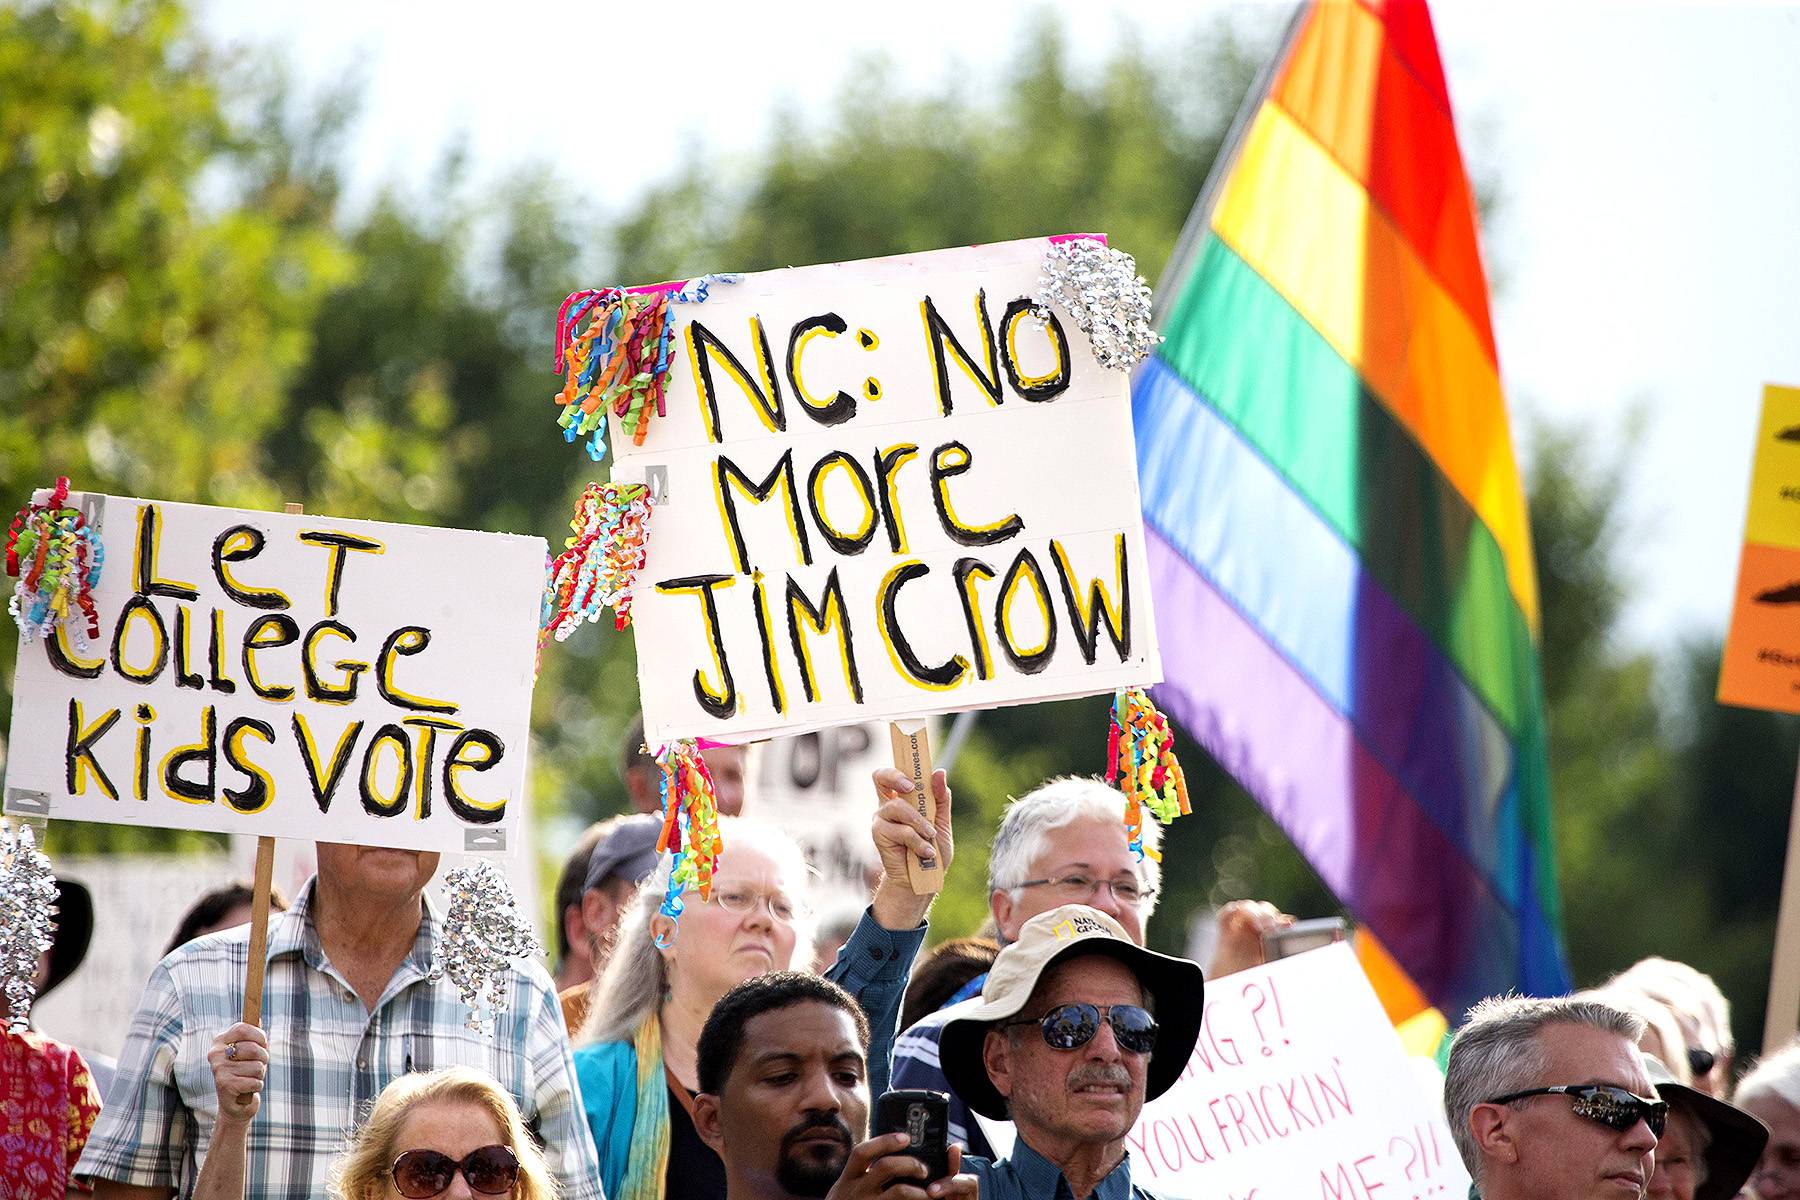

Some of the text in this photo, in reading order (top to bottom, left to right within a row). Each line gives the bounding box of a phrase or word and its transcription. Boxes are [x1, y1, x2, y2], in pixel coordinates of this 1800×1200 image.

[684, 287, 1071, 443] NC: NO
[917, 792, 927, 818] shop
[1126, 1113, 1215, 1178] YOU
